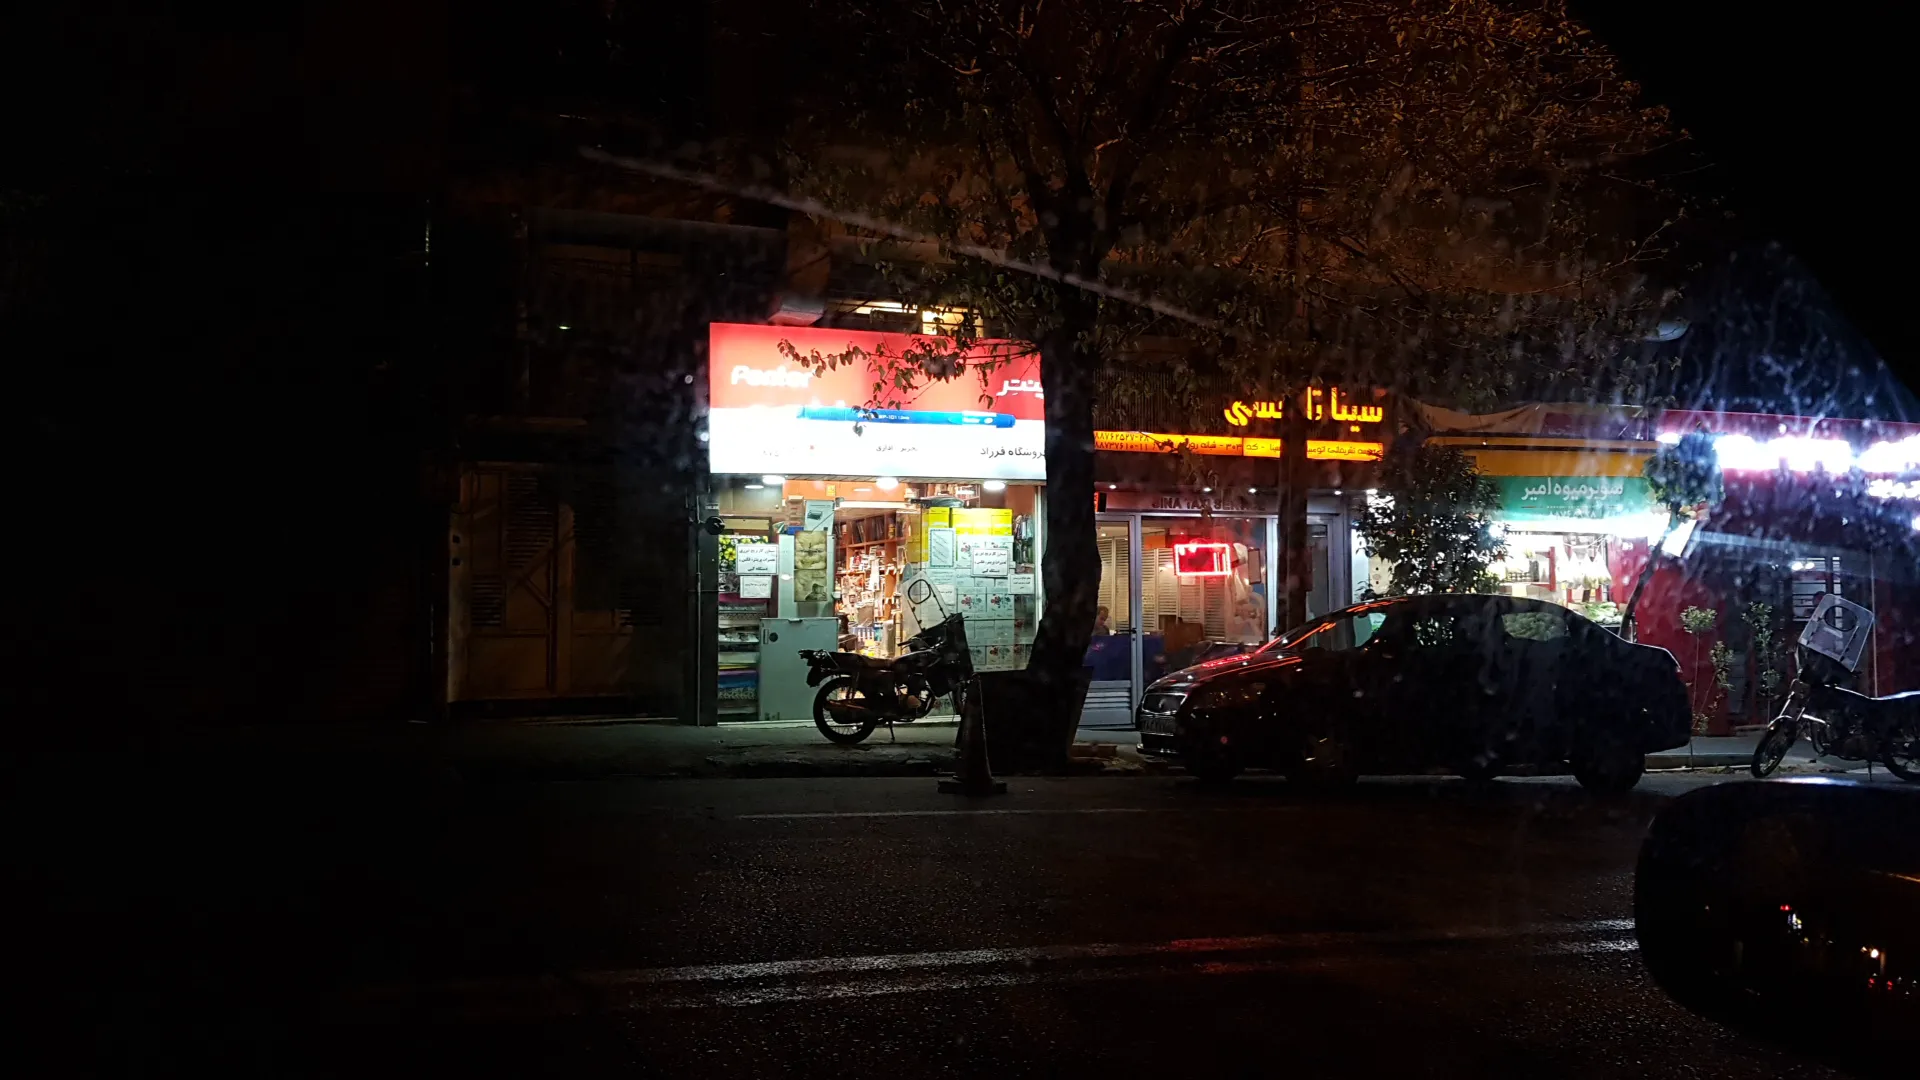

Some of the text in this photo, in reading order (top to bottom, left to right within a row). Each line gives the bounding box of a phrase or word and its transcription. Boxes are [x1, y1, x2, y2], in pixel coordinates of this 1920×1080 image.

[1224, 386, 1322, 427] تاسی
[980, 446, 1045, 460] روشگاه فرزاد
[1521, 477, 1551, 500] امیر
